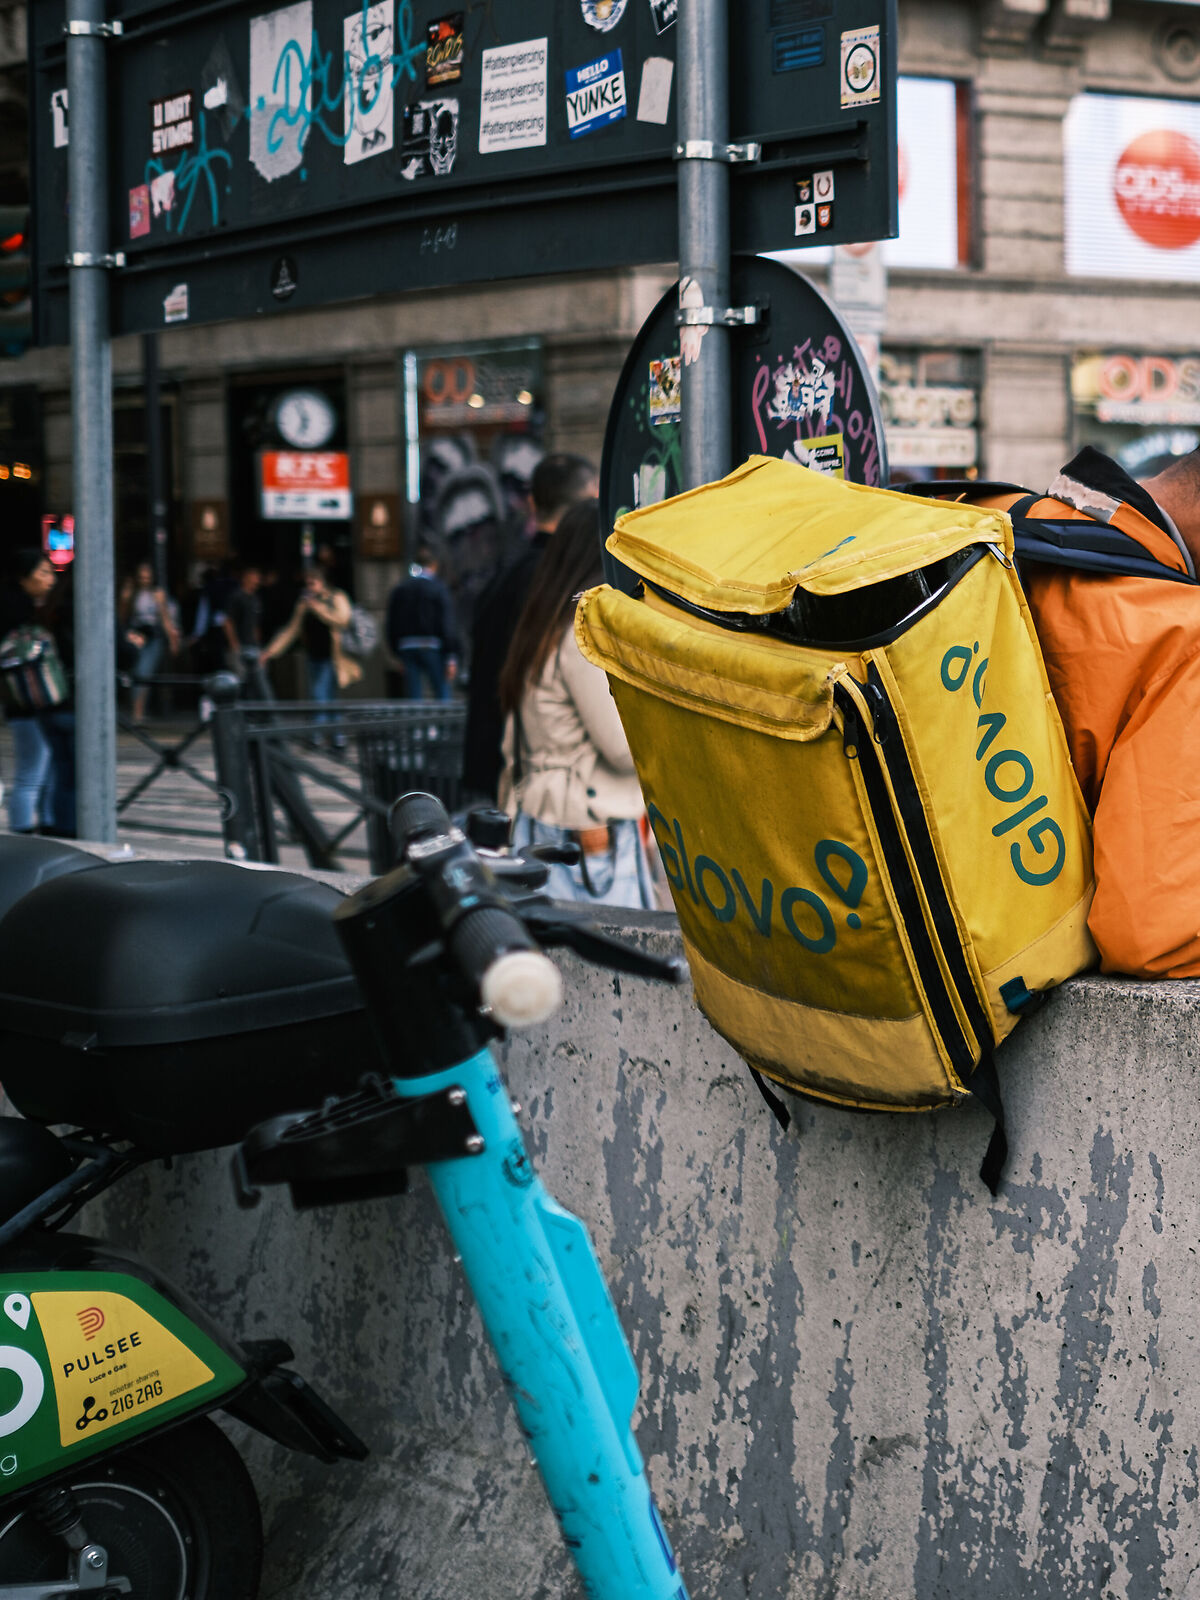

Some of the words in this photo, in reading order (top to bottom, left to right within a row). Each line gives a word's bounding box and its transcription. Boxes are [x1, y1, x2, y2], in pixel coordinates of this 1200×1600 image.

[577, 59, 609, 83] HELLO
[566, 76, 623, 122] YUNKE
[63, 1331, 142, 1378] PULSEE
[89, 1373, 106, 1384] Luce
[113, 1363, 127, 1373] Gas
[109, 1381, 134, 1397] scooter
[135, 1369, 160, 1384] sharing
[111, 1393, 134, 1416] ZIG
[135, 1380, 163, 1405] ZAG
